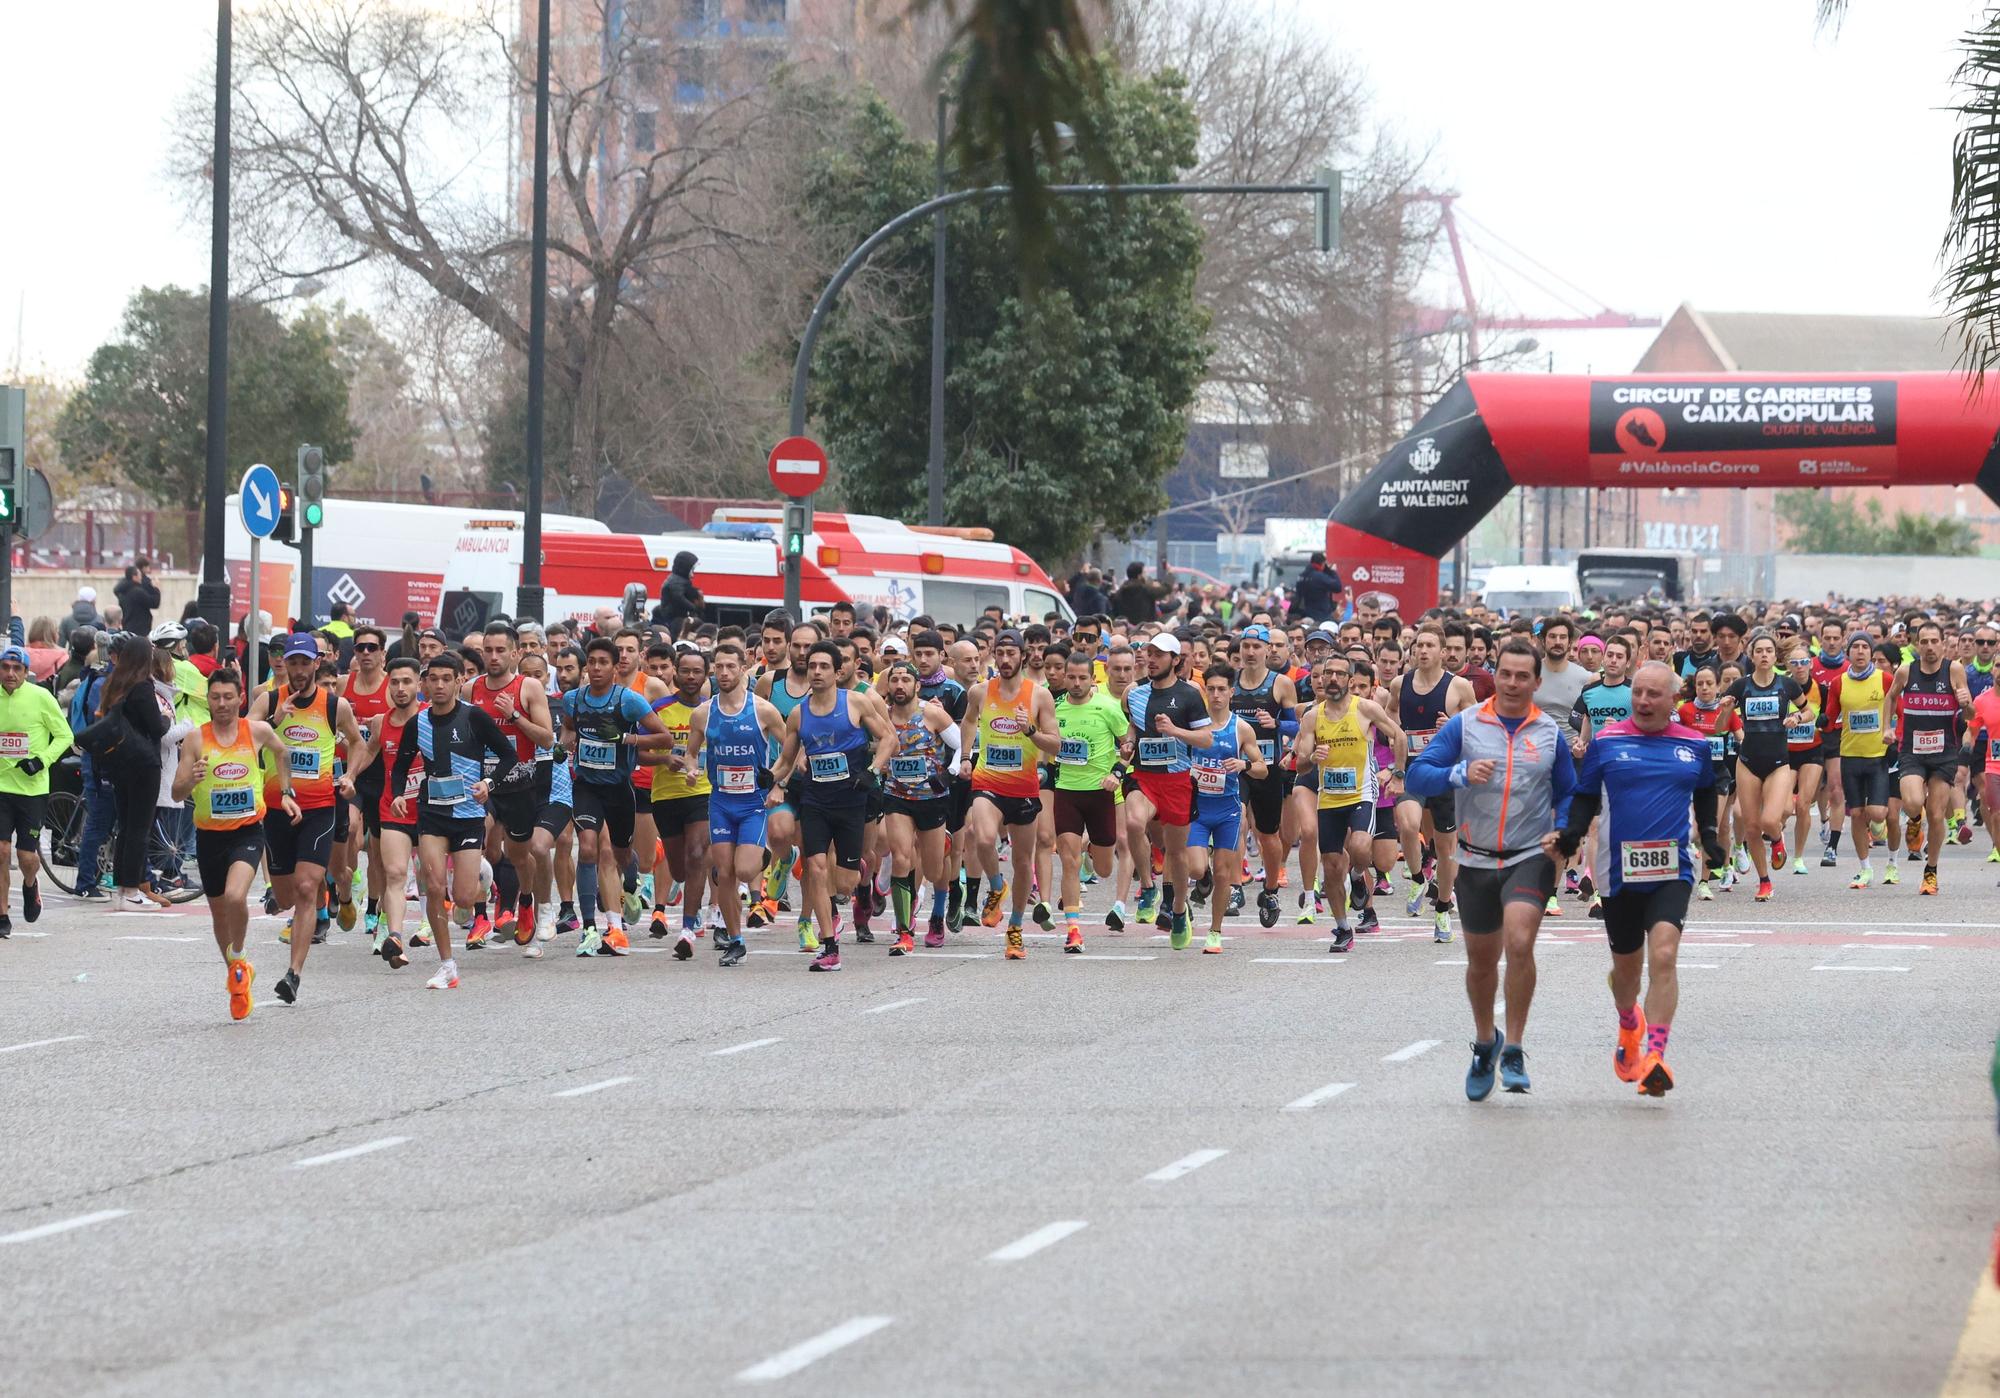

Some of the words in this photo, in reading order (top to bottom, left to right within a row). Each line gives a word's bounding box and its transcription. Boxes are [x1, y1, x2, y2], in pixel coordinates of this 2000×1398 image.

[1613, 387, 1704, 403] CIRCUIT
[1709, 387, 1741, 403] DE
[1744, 387, 1873, 403] CARRERES
[1682, 404, 1761, 423] CAIXA
[1761, 403, 1875, 422] POPULAR
[1762, 424, 1801, 436] CIUTAT
[1802, 424, 1818, 436] DE
[1619, 461, 1760, 474] #ValènciaCorre
[1380, 479, 1470, 494] AJUNTAMENT
[1378, 494, 1397, 508] DE
[1401, 492, 1469, 508] VALÈNCIA
[455, 536, 510, 553] AMBULANCIA
[1589, 707, 1628, 717] CRESPO
[1852, 713, 1875, 725] 2035
[992, 721, 1020, 731] Serrano
[287, 728, 316, 739] Serrano
[1, 737, 22, 748] 290
[1919, 736, 1938, 745] 858
[584, 744, 608, 759] 2217
[714, 744, 755, 756] ALPESA
[989, 747, 1016, 761] 2298
[1144, 742, 1169, 755] 2514
[290, 751, 314, 767] 063
[815, 757, 840, 771] 2251
[894, 759, 920, 772] 2252
[216, 767, 247, 777] Serrano
[730, 772, 746, 783] 27
[215, 791, 248, 807] 2289
[1629, 850, 1670, 868] 6388
